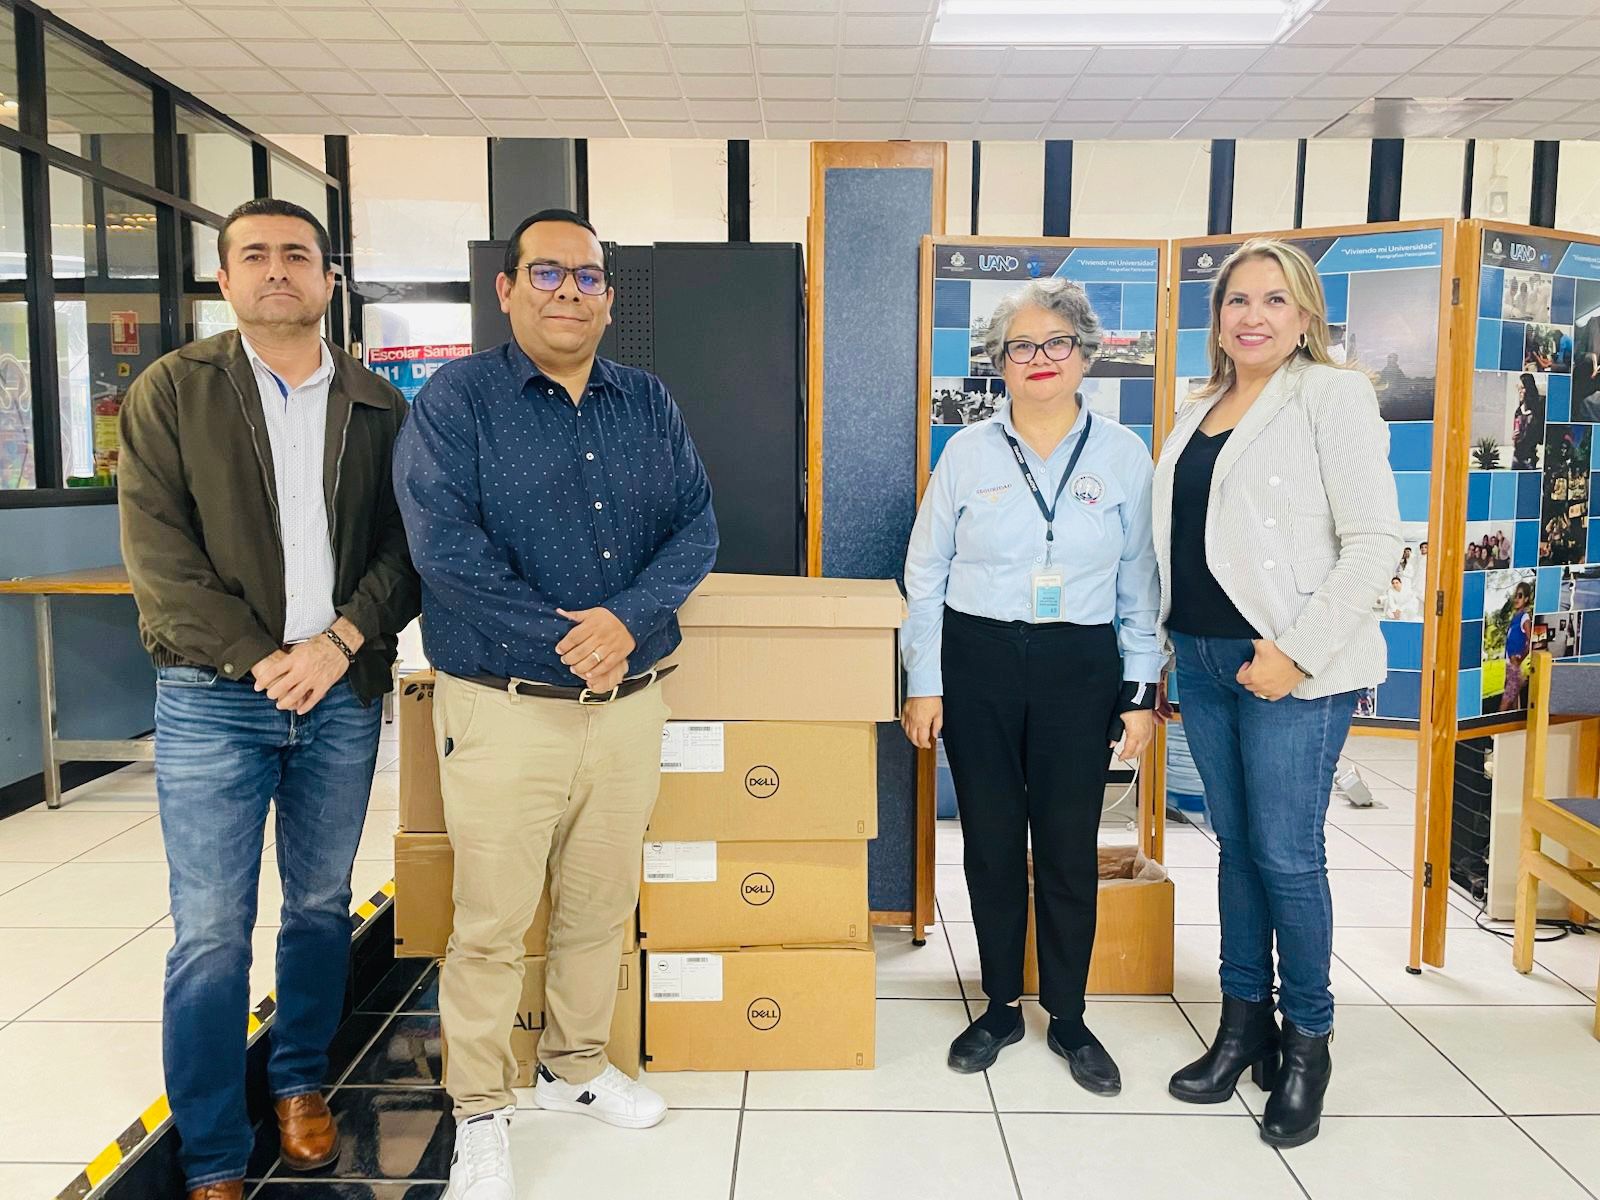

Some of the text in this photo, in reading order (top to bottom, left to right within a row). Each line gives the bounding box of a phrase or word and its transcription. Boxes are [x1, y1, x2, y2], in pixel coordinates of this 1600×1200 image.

[371, 347, 421, 361] Escolar
[750, 778, 776, 786] DELL
[745, 885, 771, 893] DELL
[752, 1010, 777, 1018] DELL
